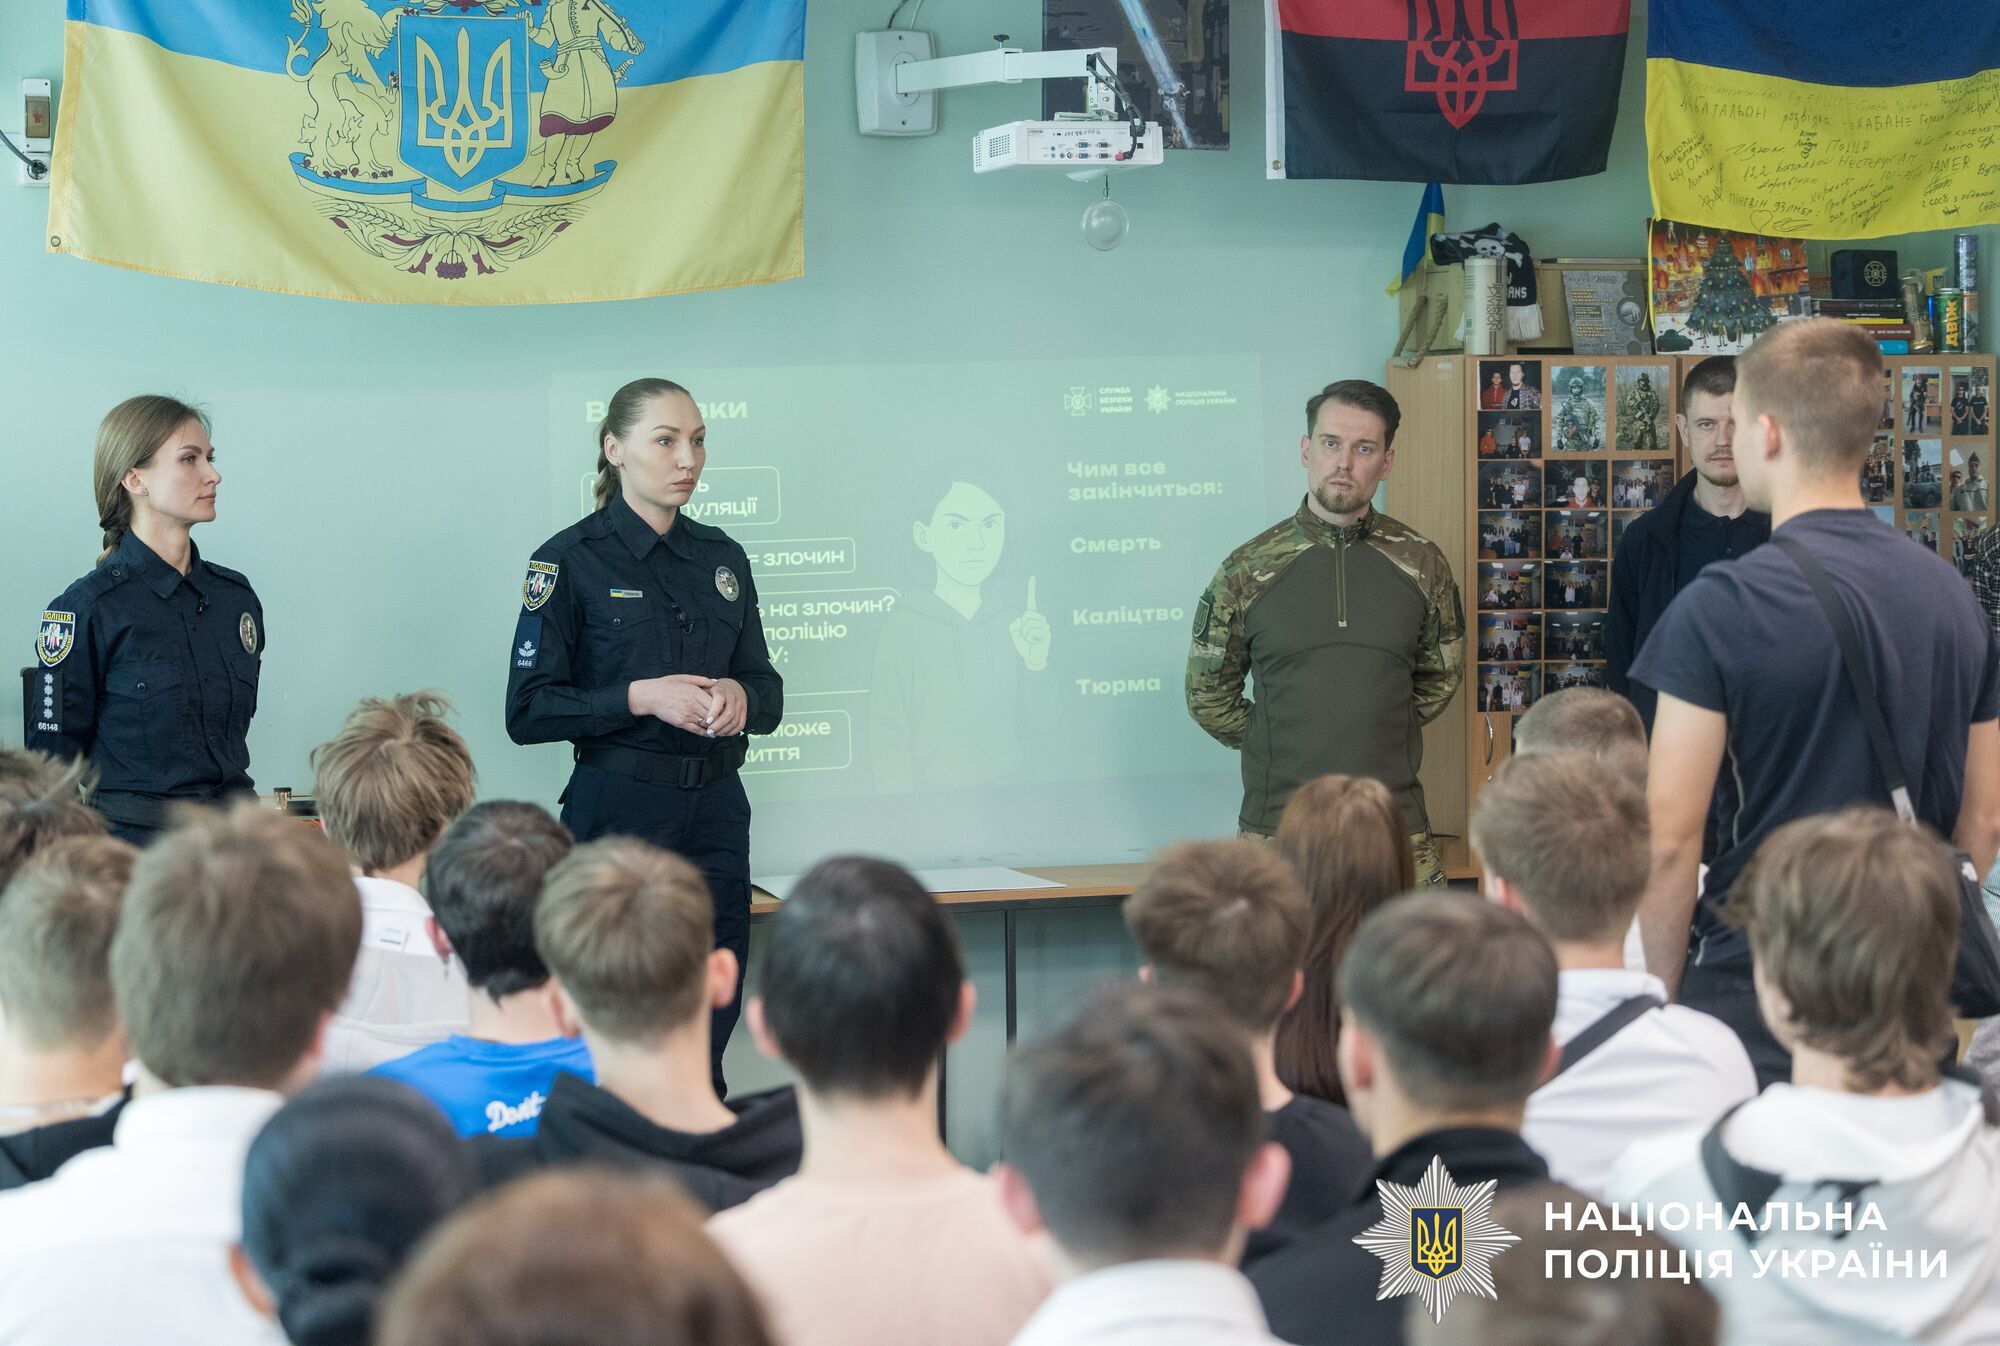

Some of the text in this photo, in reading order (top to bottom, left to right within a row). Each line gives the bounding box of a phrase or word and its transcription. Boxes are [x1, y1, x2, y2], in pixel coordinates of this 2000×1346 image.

[1067, 461, 1166, 478] Чим все
[1067, 480, 1223, 502] закінчиться:
[1070, 536, 1162, 554] Смерть
[763, 550, 845, 566] злочин
[530, 562, 557, 573] ПОЛІЦІЯ
[770, 603, 797, 617] на
[802, 595, 896, 616] злочин?
[1072, 604, 1184, 626] Каліцтво
[43, 612, 72, 621] ПОЛІЦІЯ
[1075, 677, 1161, 696] Тюрма
